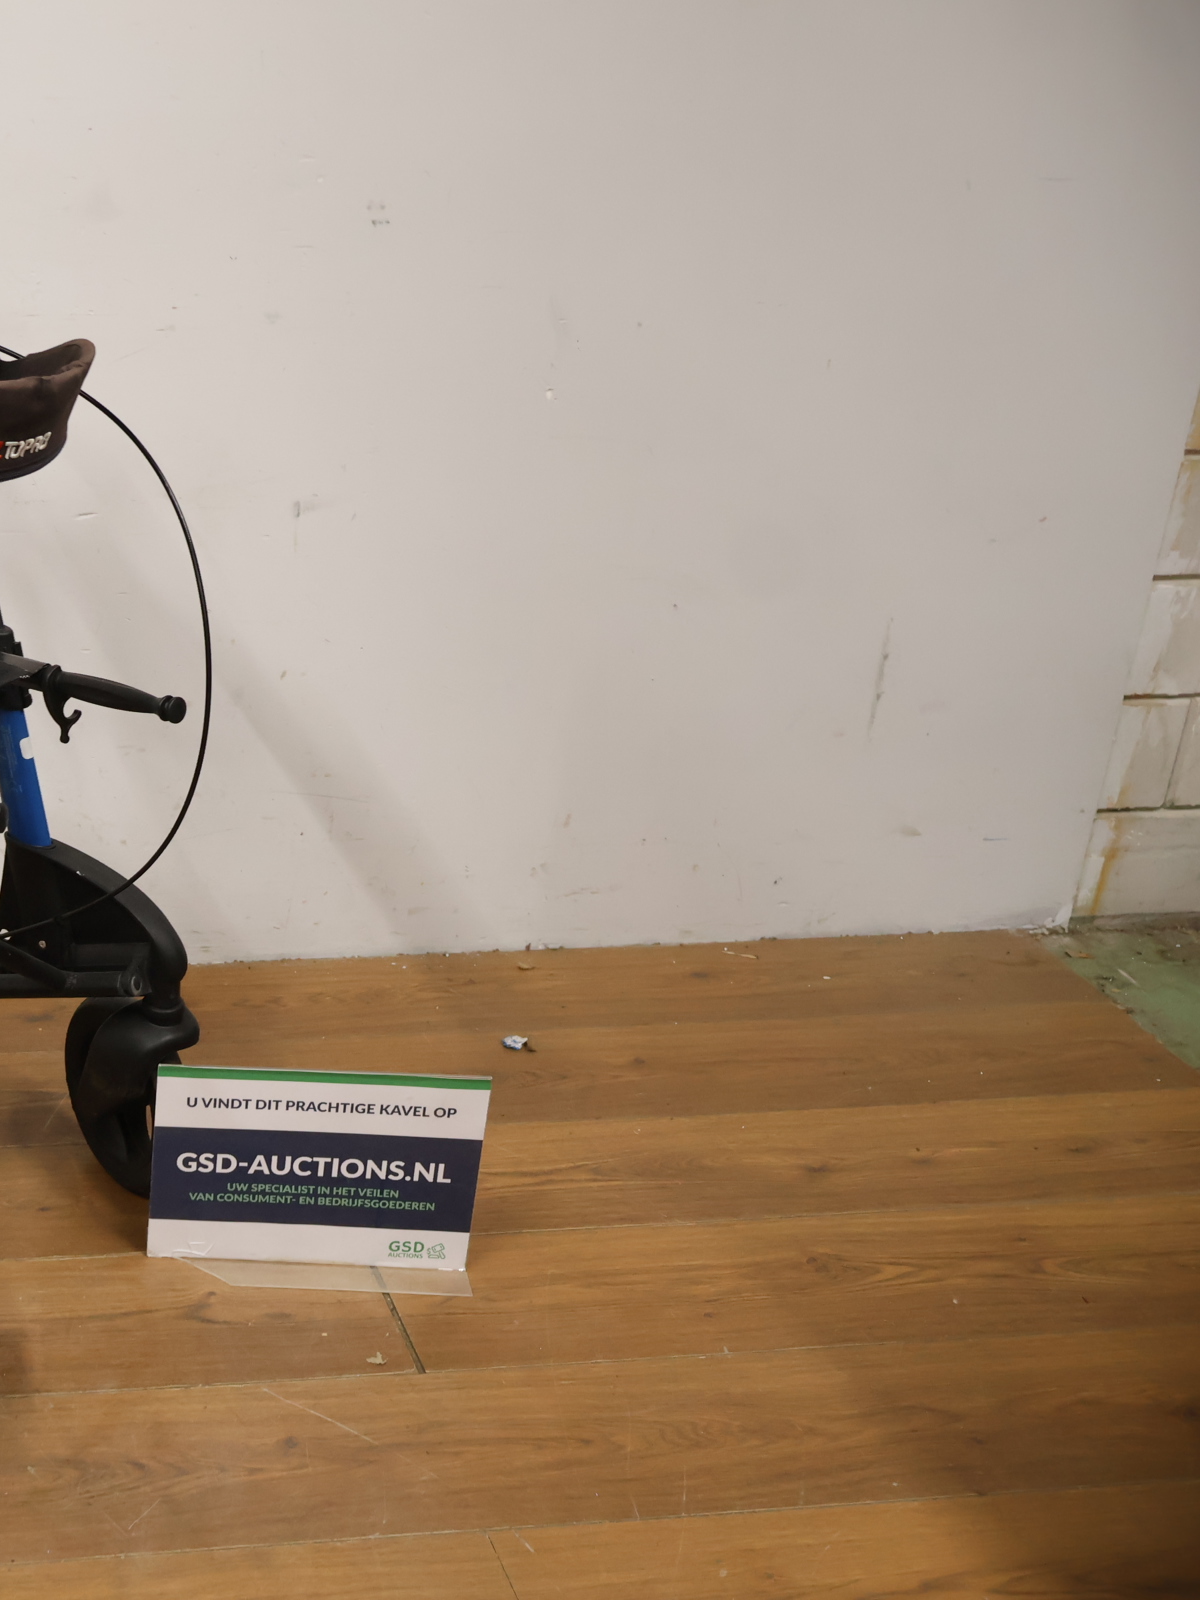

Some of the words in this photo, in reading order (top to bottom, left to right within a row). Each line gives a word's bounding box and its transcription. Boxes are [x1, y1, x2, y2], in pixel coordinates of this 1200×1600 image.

[4, 431, 52, 459] TOPRO
[186, 1096, 198, 1108] U
[201, 1097, 252, 1109] VINDT
[255, 1099, 282, 1111] DIT
[285, 1100, 376, 1115] PRACHTIGE
[379, 1104, 430, 1118] KAVEL
[433, 1107, 458, 1119] OP
[176, 1152, 452, 1184] GSD-AUCTIONS.NL
[227, 1182, 249, 1192] UW
[250, 1183, 316, 1195] SPECIALIST
[317, 1185, 330, 1195] IN
[332, 1186, 357, 1197] HET
[357, 1188, 400, 1199] VEILEN
[188, 1192, 214, 1202] VAN
[216, 1193, 297, 1205] CONSUMENT-
[298, 1195, 315, 1205] EN
[317, 1196, 436, 1212] BEDRIJFSGOEDEREN
[387, 1252, 424, 1260] AUCTIONS
[388, 1240, 425, 1253] GSD
